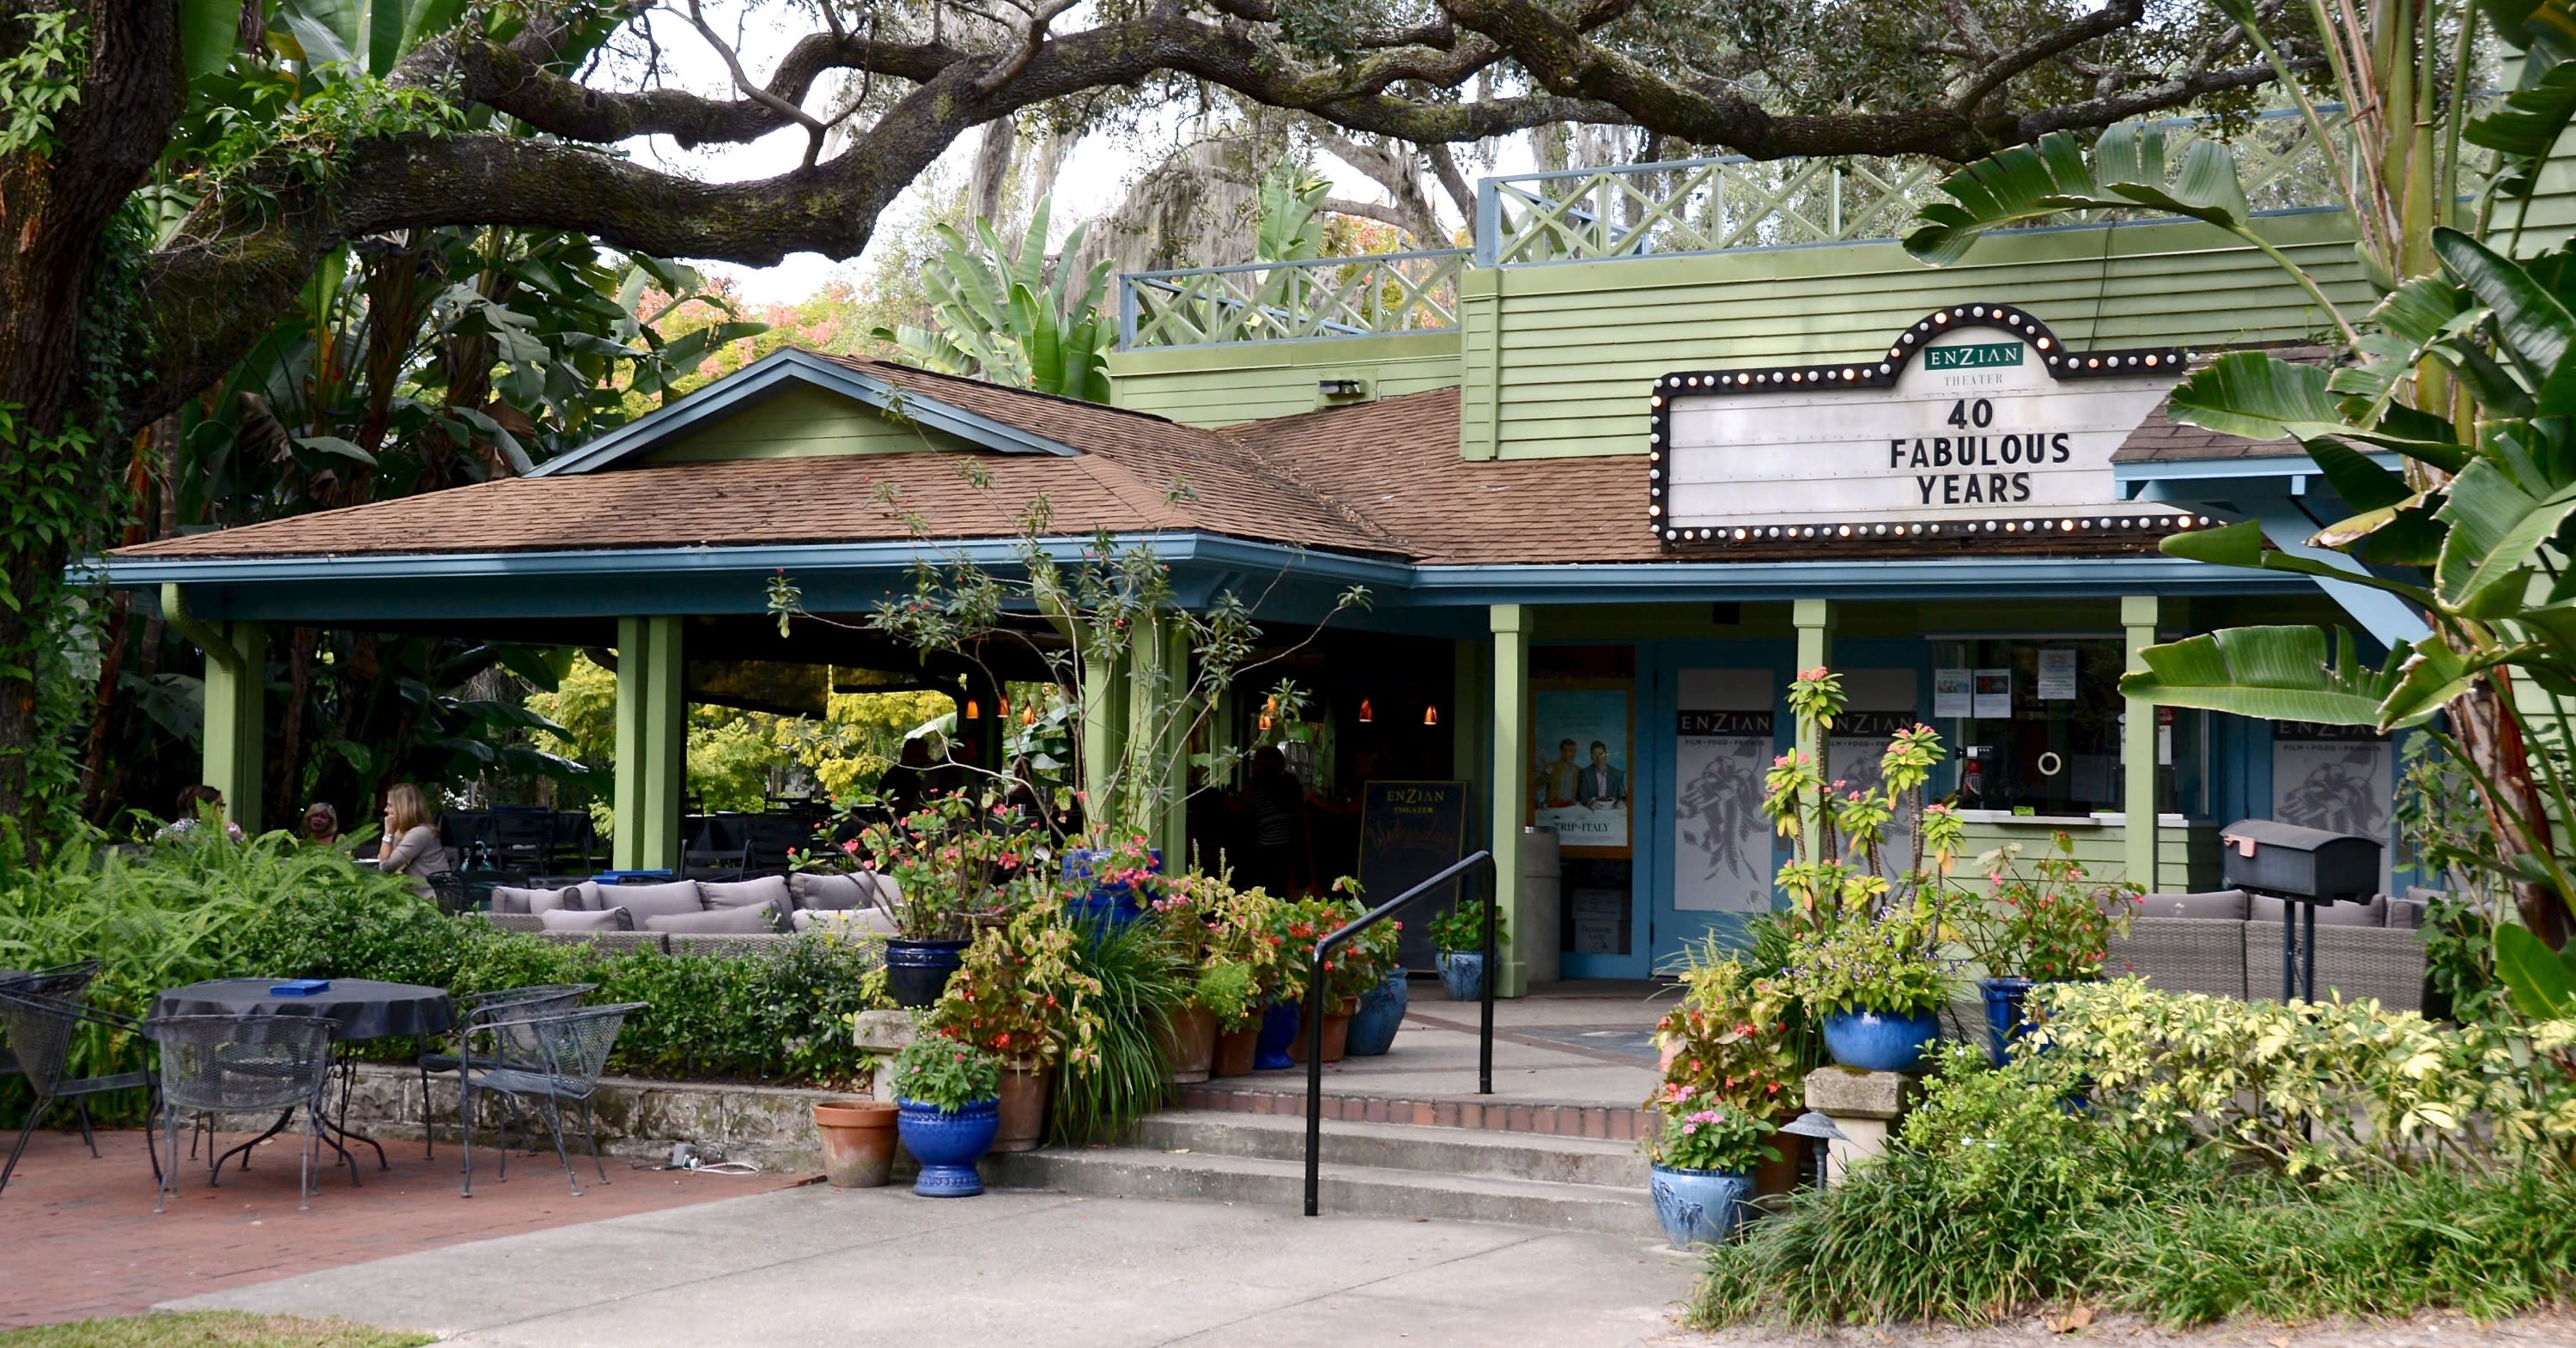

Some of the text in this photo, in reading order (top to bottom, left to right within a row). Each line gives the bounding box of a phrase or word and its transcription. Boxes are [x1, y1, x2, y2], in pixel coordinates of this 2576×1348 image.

[1930, 348, 2017, 366] ENZIAN
[1944, 373, 2002, 386] THEATER
[1947, 398, 1993, 429] 40
[1891, 433, 2070, 468] FABULOUS
[1917, 472, 2031, 504] YEARS
[1681, 713, 1770, 732] ENZIAN
[1835, 713, 1913, 733] NZIAN
[2279, 720, 2377, 737] ENZIA
[1387, 789, 1444, 804] ENZIAN
[1582, 823, 1610, 832] ITALY
